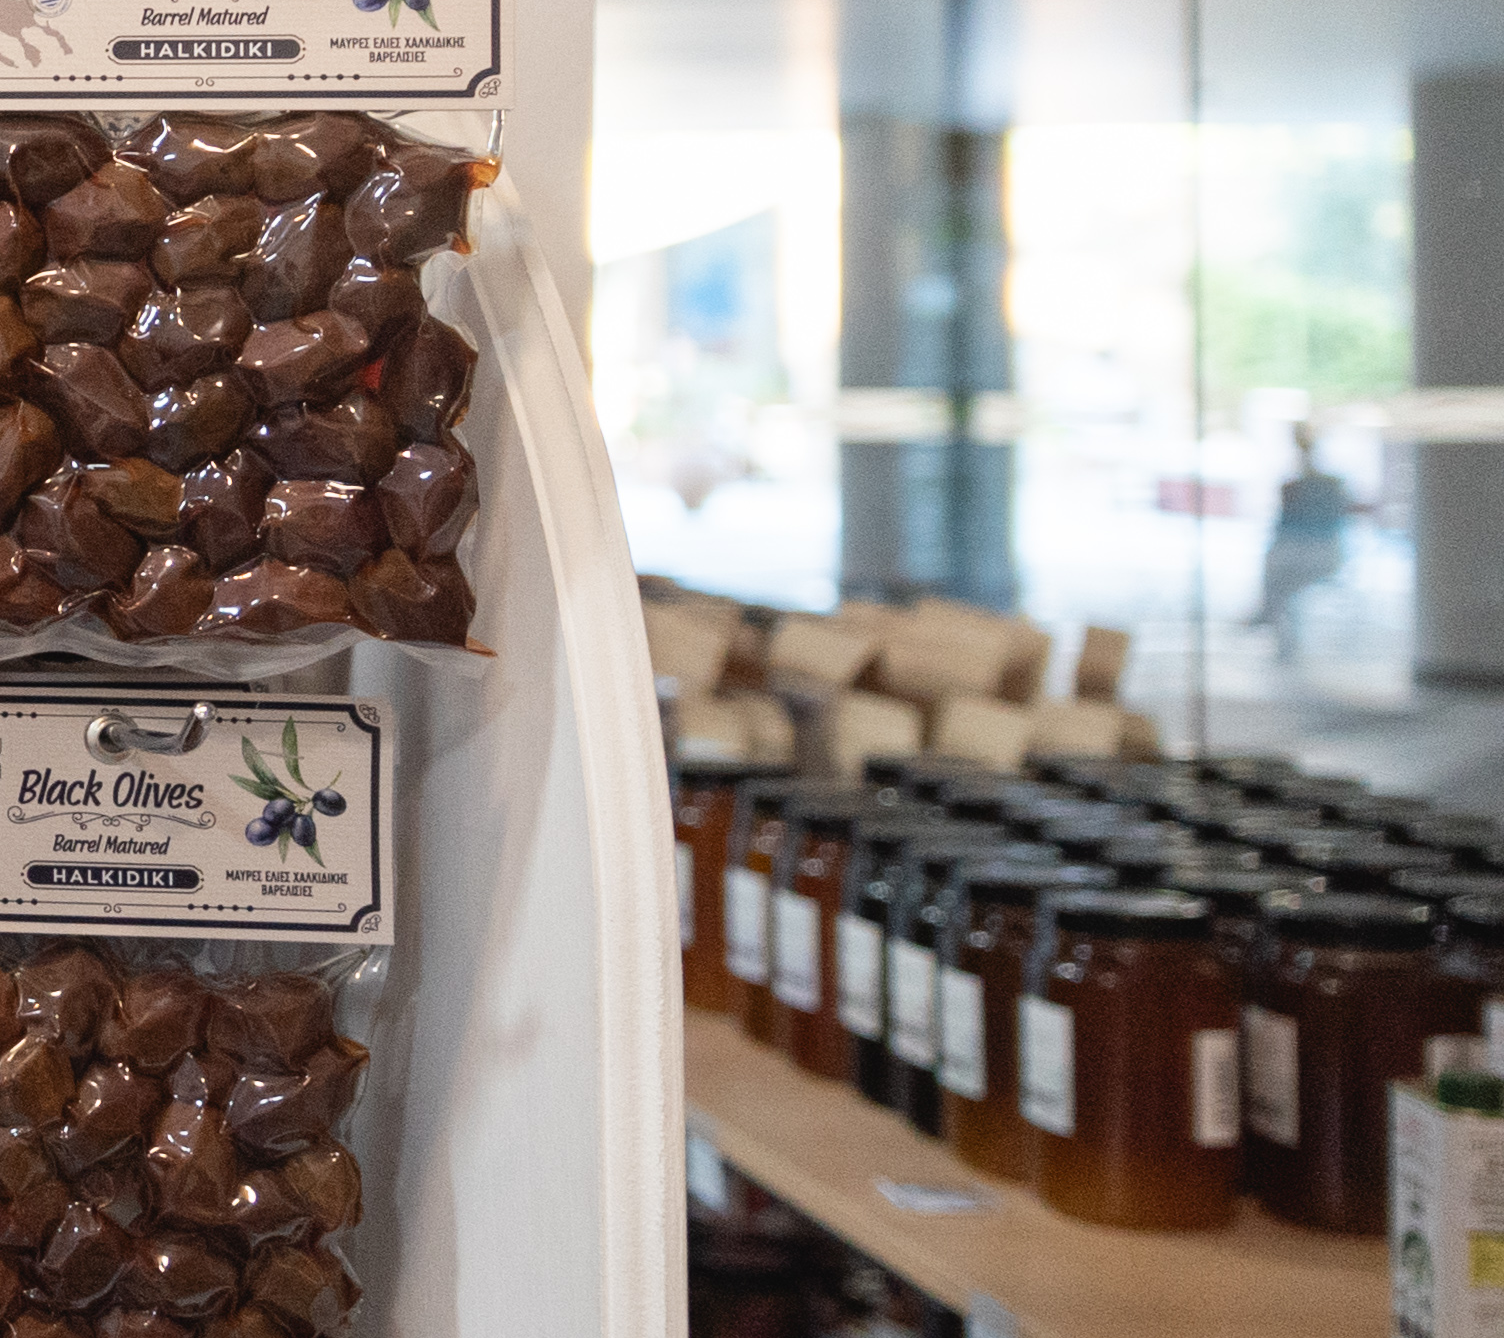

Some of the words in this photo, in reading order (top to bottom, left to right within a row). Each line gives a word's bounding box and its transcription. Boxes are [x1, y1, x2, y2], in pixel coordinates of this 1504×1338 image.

[141, 7, 195, 26] Barrel
[197, 6, 269, 25] Matured
[141, 42, 271, 57] HALKIDIKI
[330, 38, 370, 49] ΜΑΥΡΕΣ
[373, 37, 401, 49] ΕΛΙΕΣ
[405, 37, 465, 48] ΧΑΛΚΙΔΙΚΗΣ
[369, 51, 426, 63] ΒΑΡΕΛΙΣΙΕΣ
[18, 768, 103, 806] Black
[113, 770, 204, 809] Olives
[53, 834, 102, 853] Barrel
[104, 836, 171, 855] Matured
[53, 868, 173, 886] HALKIDIKI
[226, 870, 262, 882] ΜΑΥΡΕΣ
[265, 871, 290, 883] ΕΛΙΕΣ
[293, 872, 348, 884] ΧΑΛΚΙΔΙΚΗΣ
[261, 884, 313, 897] ΒΑΡΕΛΙΣΙΕΣ
